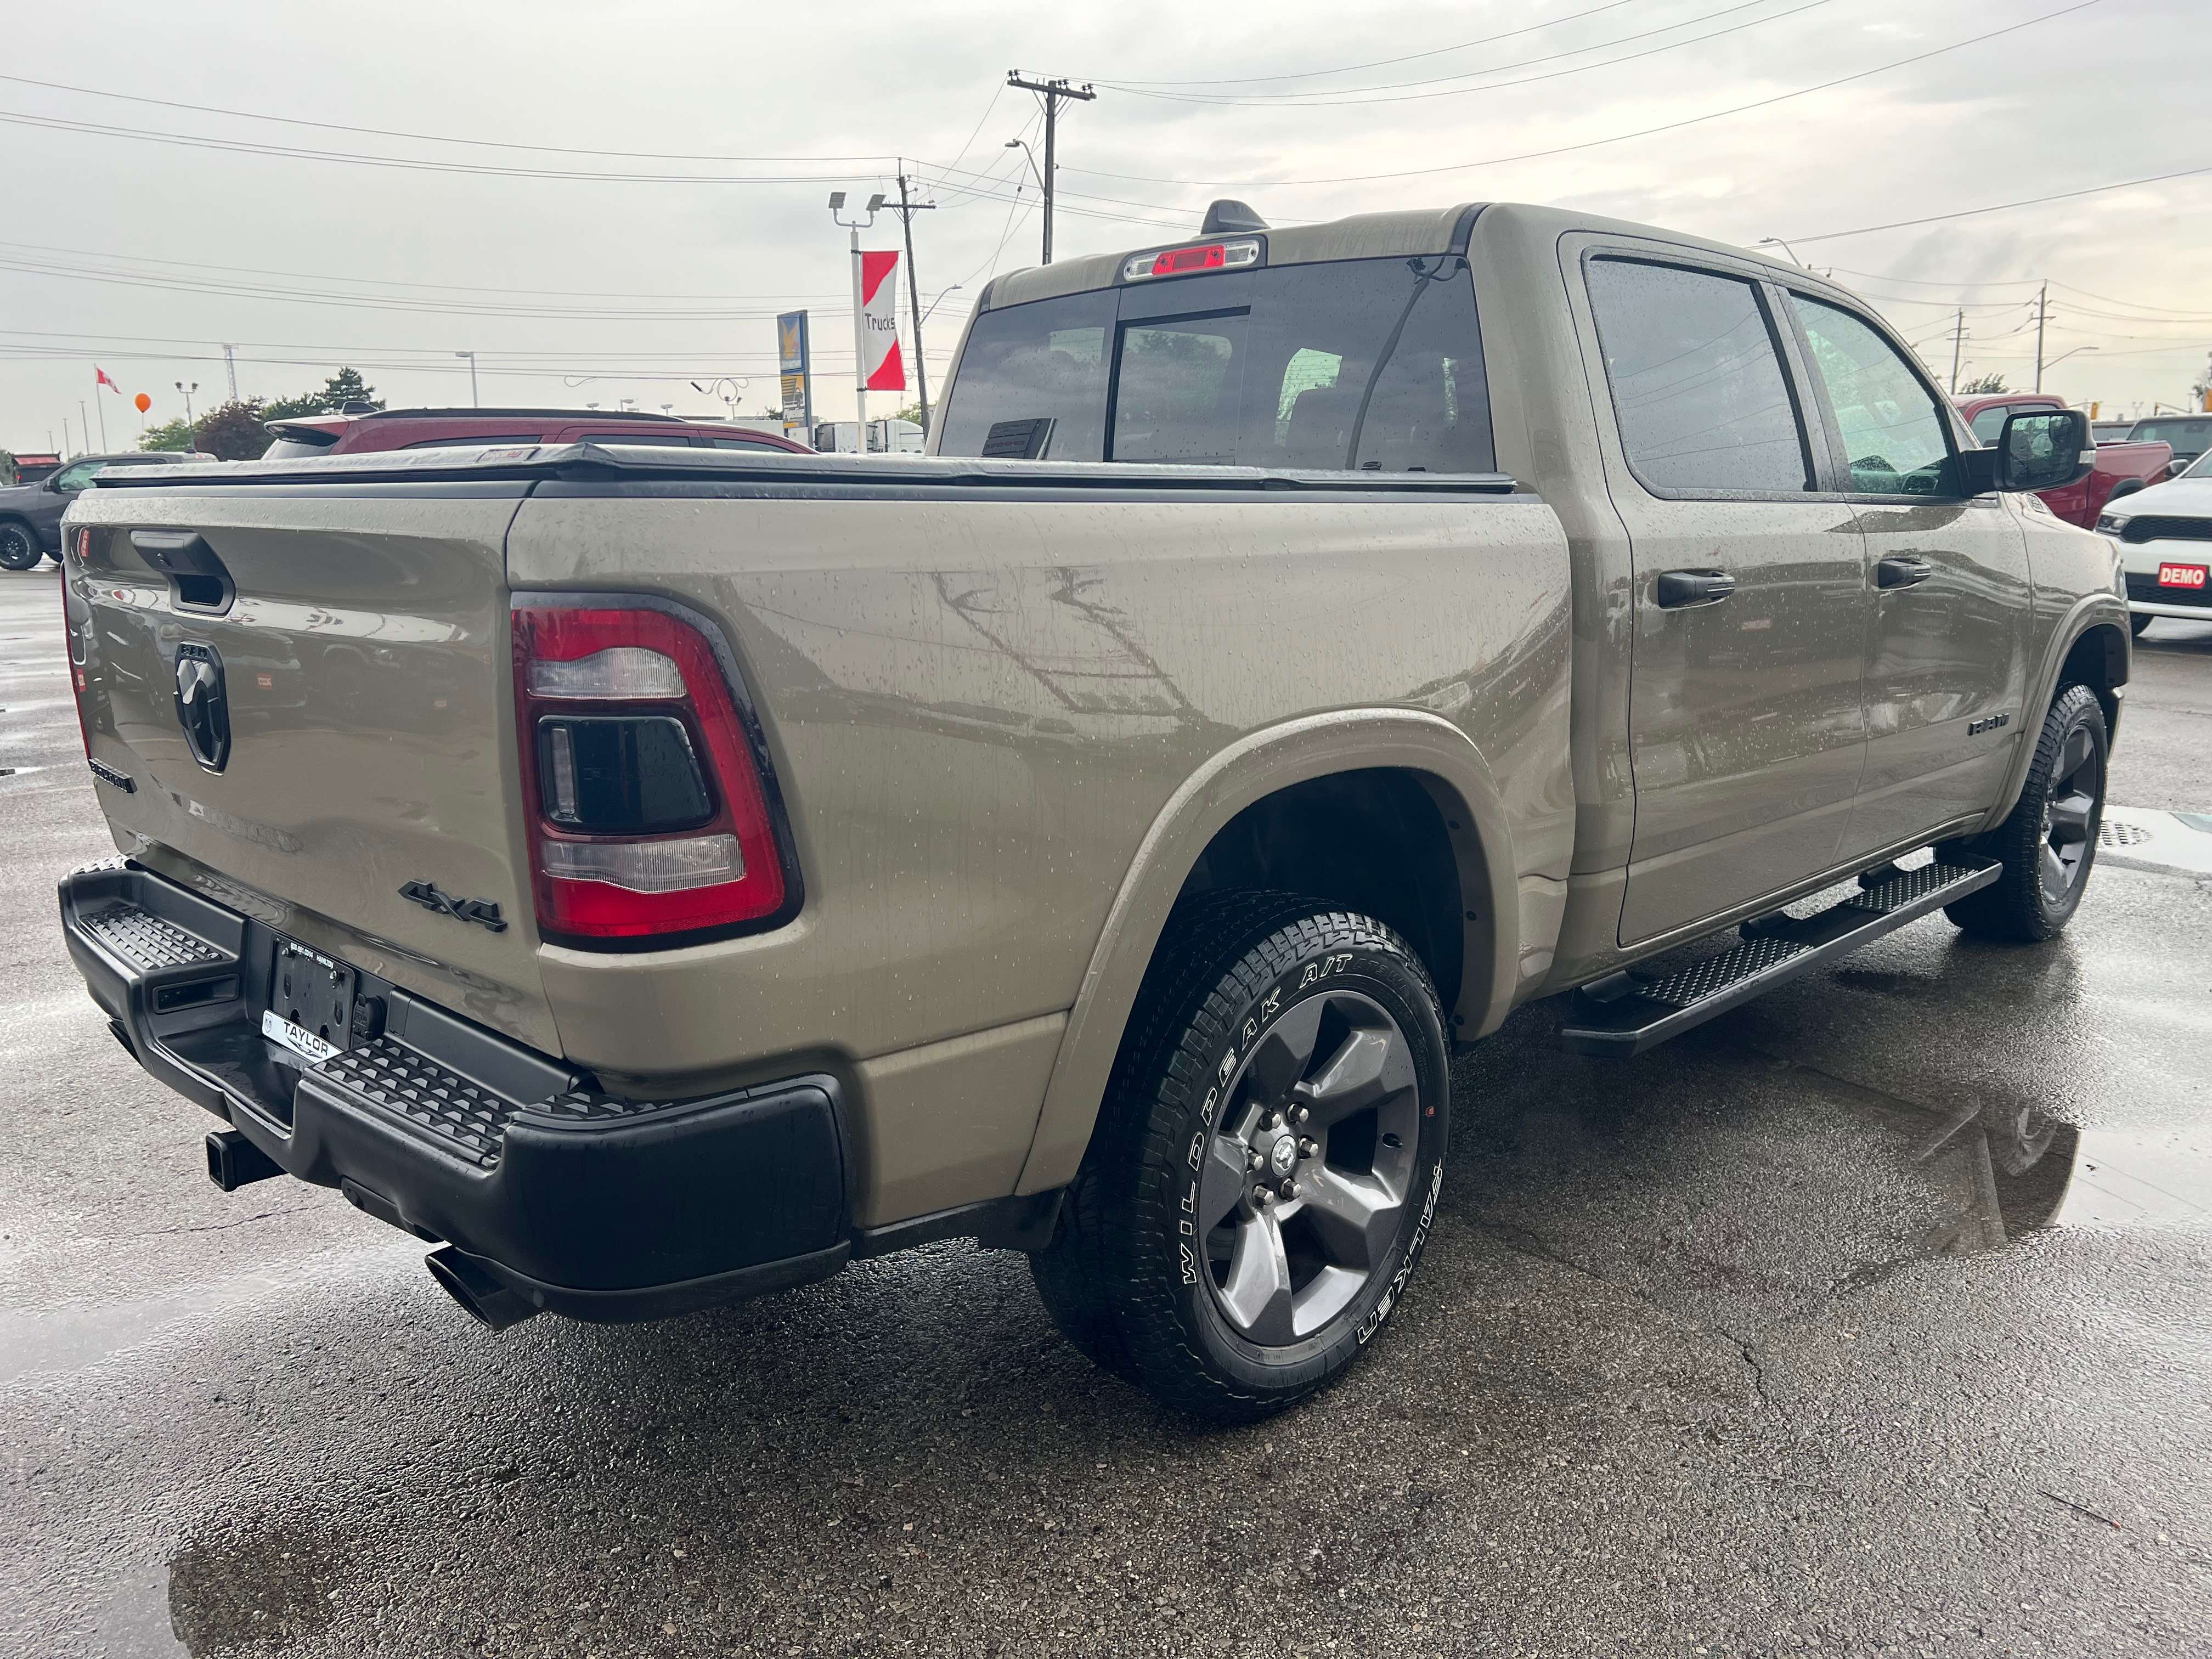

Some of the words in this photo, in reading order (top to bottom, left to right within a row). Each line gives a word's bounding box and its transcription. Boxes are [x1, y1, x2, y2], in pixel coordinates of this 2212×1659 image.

[865, 312, 896, 331] Trucks
[2160, 566, 2205, 585] DEMO
[284, 1021, 328, 1056] TAYLOR
[1180, 986, 1282, 1284] WILDPEAK
